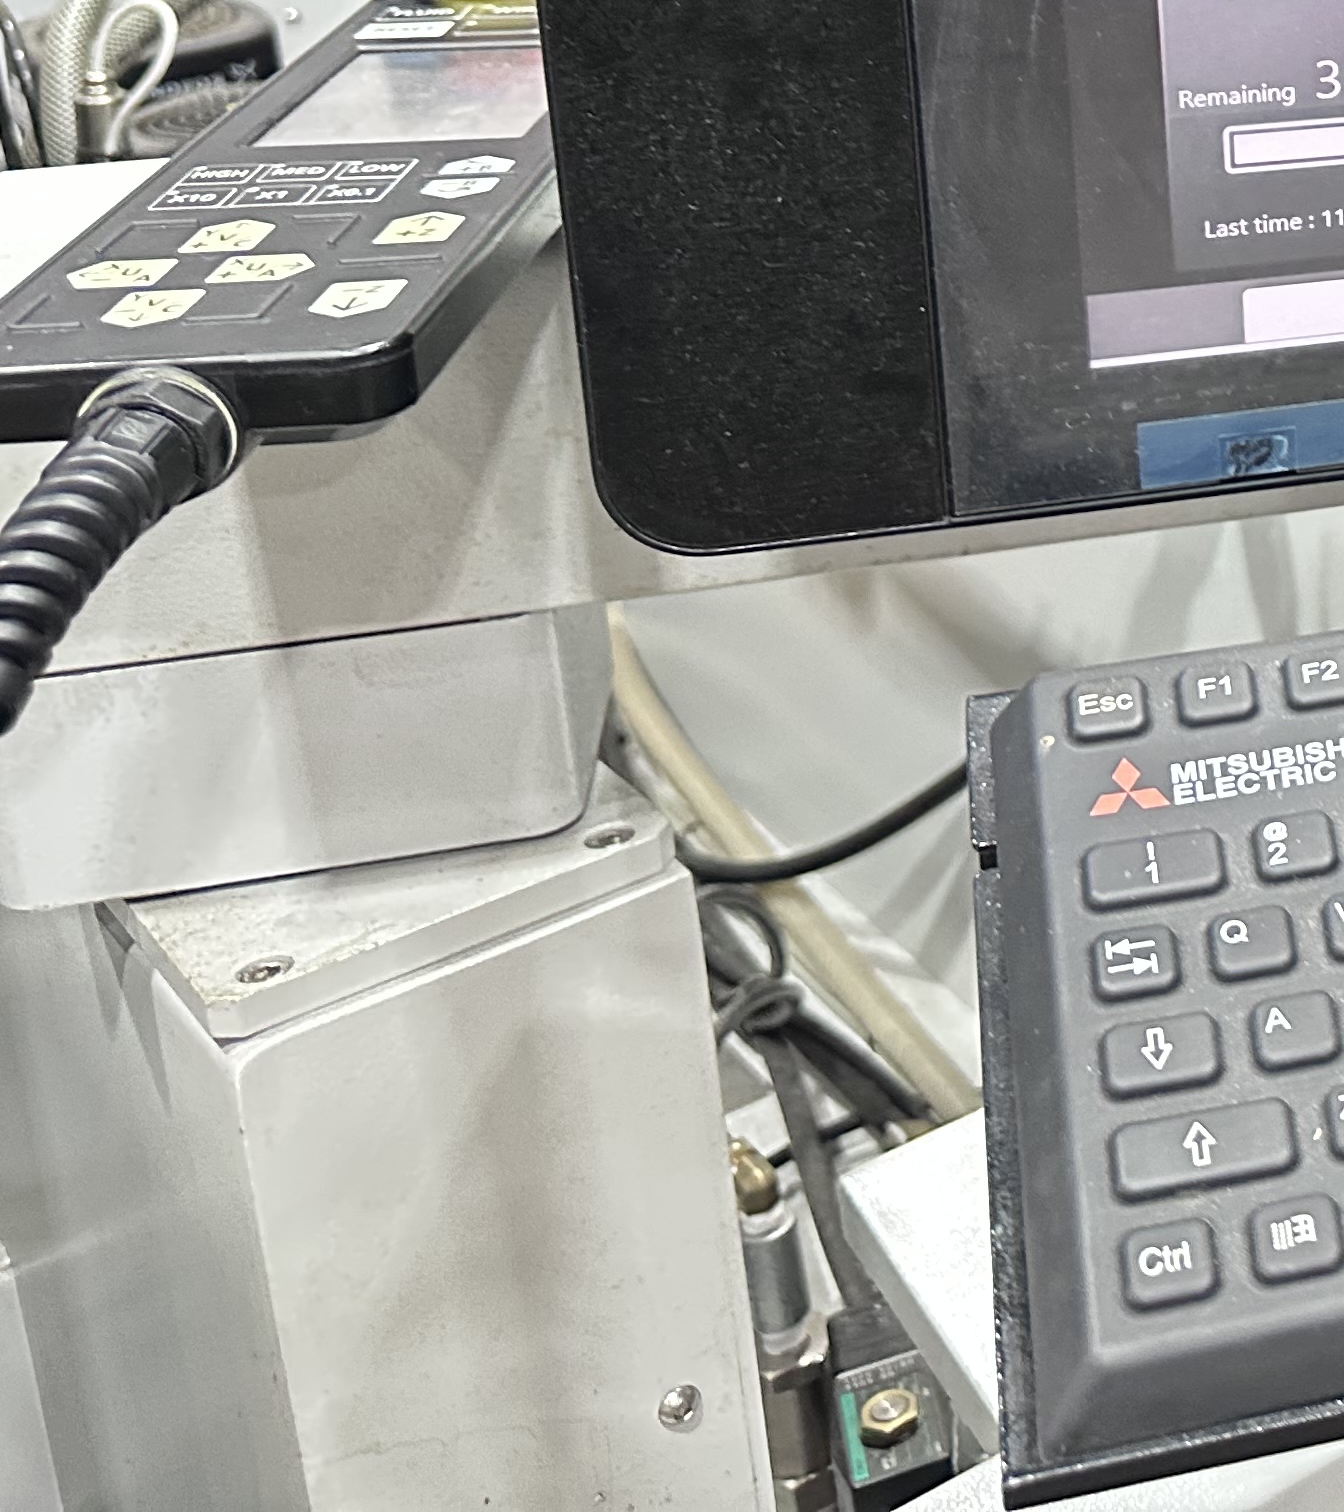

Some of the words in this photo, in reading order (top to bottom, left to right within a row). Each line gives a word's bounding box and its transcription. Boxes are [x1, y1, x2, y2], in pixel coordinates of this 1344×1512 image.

[1178, 82, 1296, 110] Remaining
[190, 168, 250, 179] HIGH
[272, 166, 326, 176] MED
[348, 163, 405, 174] LOW
[1204, 218, 1249, 239] Last
[1254, 212, 1303, 235] time
[1301, 660, 1339, 683] F2
[1197, 675, 1233, 700] F1
[1078, 692, 1134, 716] Esc
[1173, 761, 1337, 805] ELECTRIC
[1138, 1241, 1192, 1274] Ctrl
